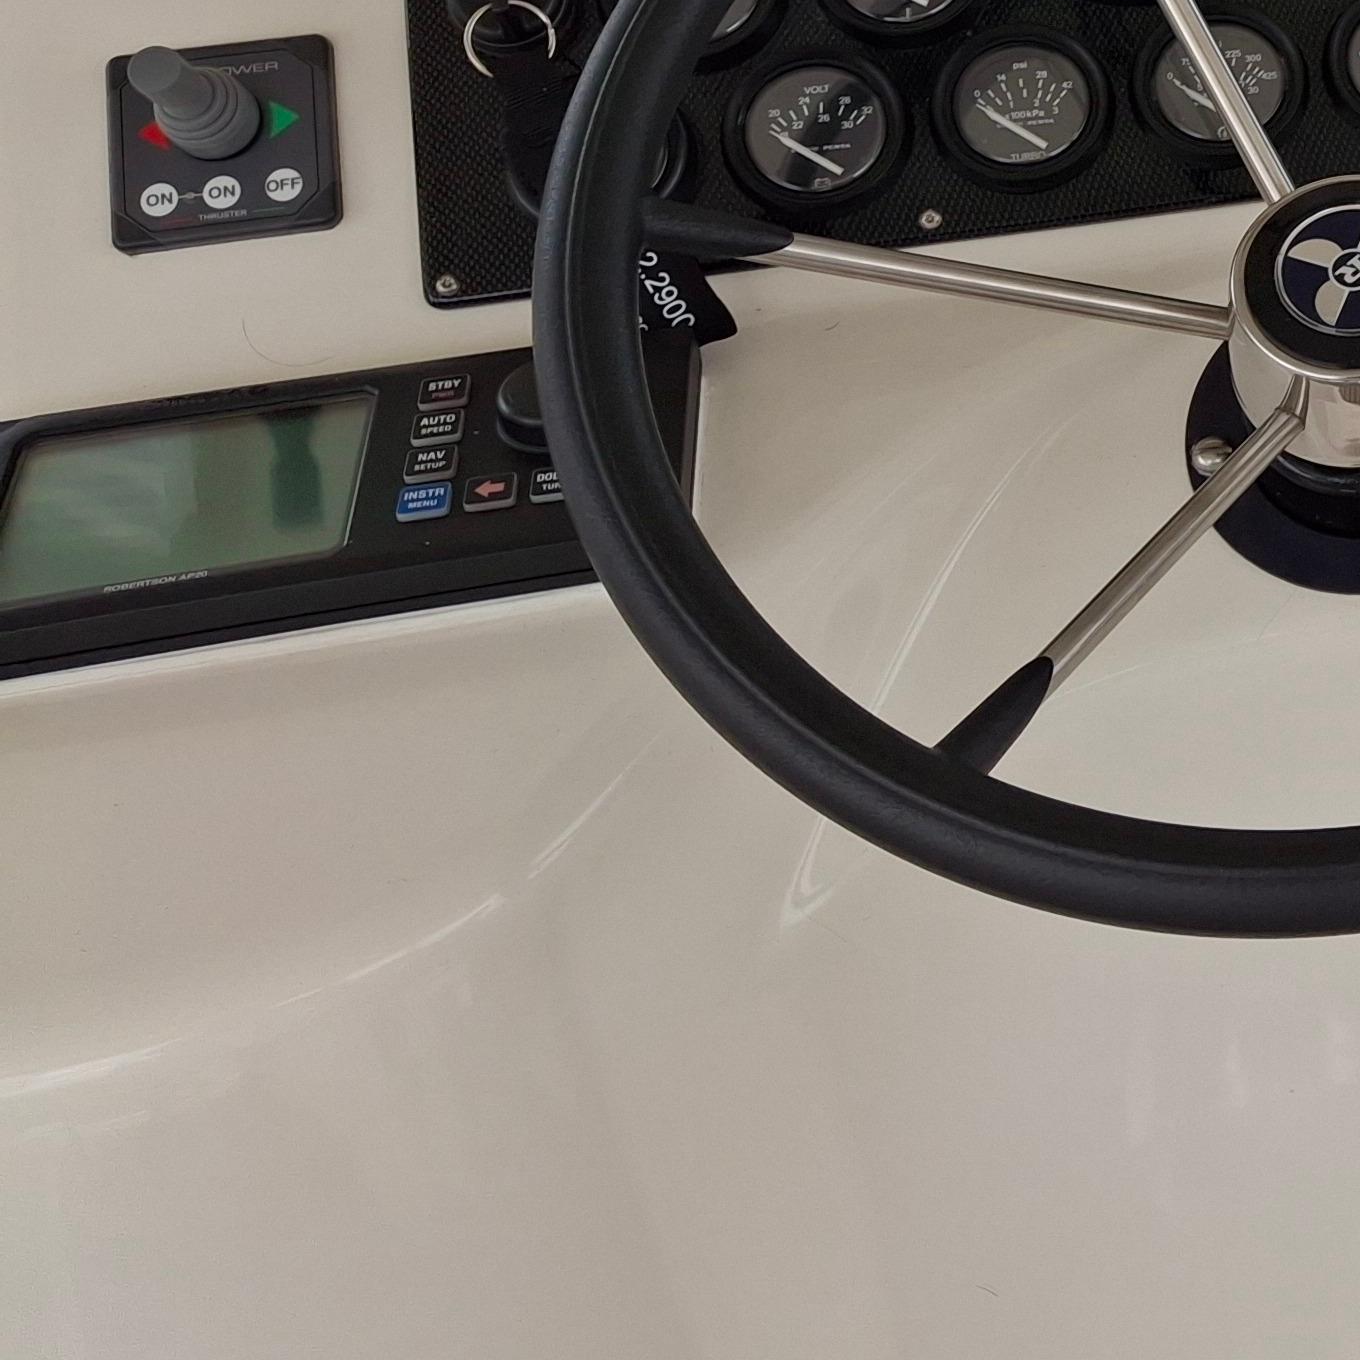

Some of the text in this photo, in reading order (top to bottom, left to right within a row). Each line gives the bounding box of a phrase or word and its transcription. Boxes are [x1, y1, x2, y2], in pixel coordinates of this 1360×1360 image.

[1012, 61, 1028, 70] psi
[803, 84, 829, 94] VOLT
[798, 96, 810, 105] 24
[768, 109, 780, 117] 20
[841, 121, 853, 129] 30
[266, 177, 301, 192] OFF
[208, 185, 236, 200] ON
[146, 192, 173, 207] ON
[199, 210, 248, 221] THRUSTER
[428, 378, 462, 391] STBY
[420, 413, 456, 427] AUTO
[420, 425, 452, 435] SPEED
[417, 450, 446, 462] NAV
[414, 460, 447, 471] SETUP
[542, 483, 562, 491] TUR
[403, 486, 444, 501] INSTR
[407, 498, 438, 509] MENU
[103, 575, 177, 593] ROBERTSON
